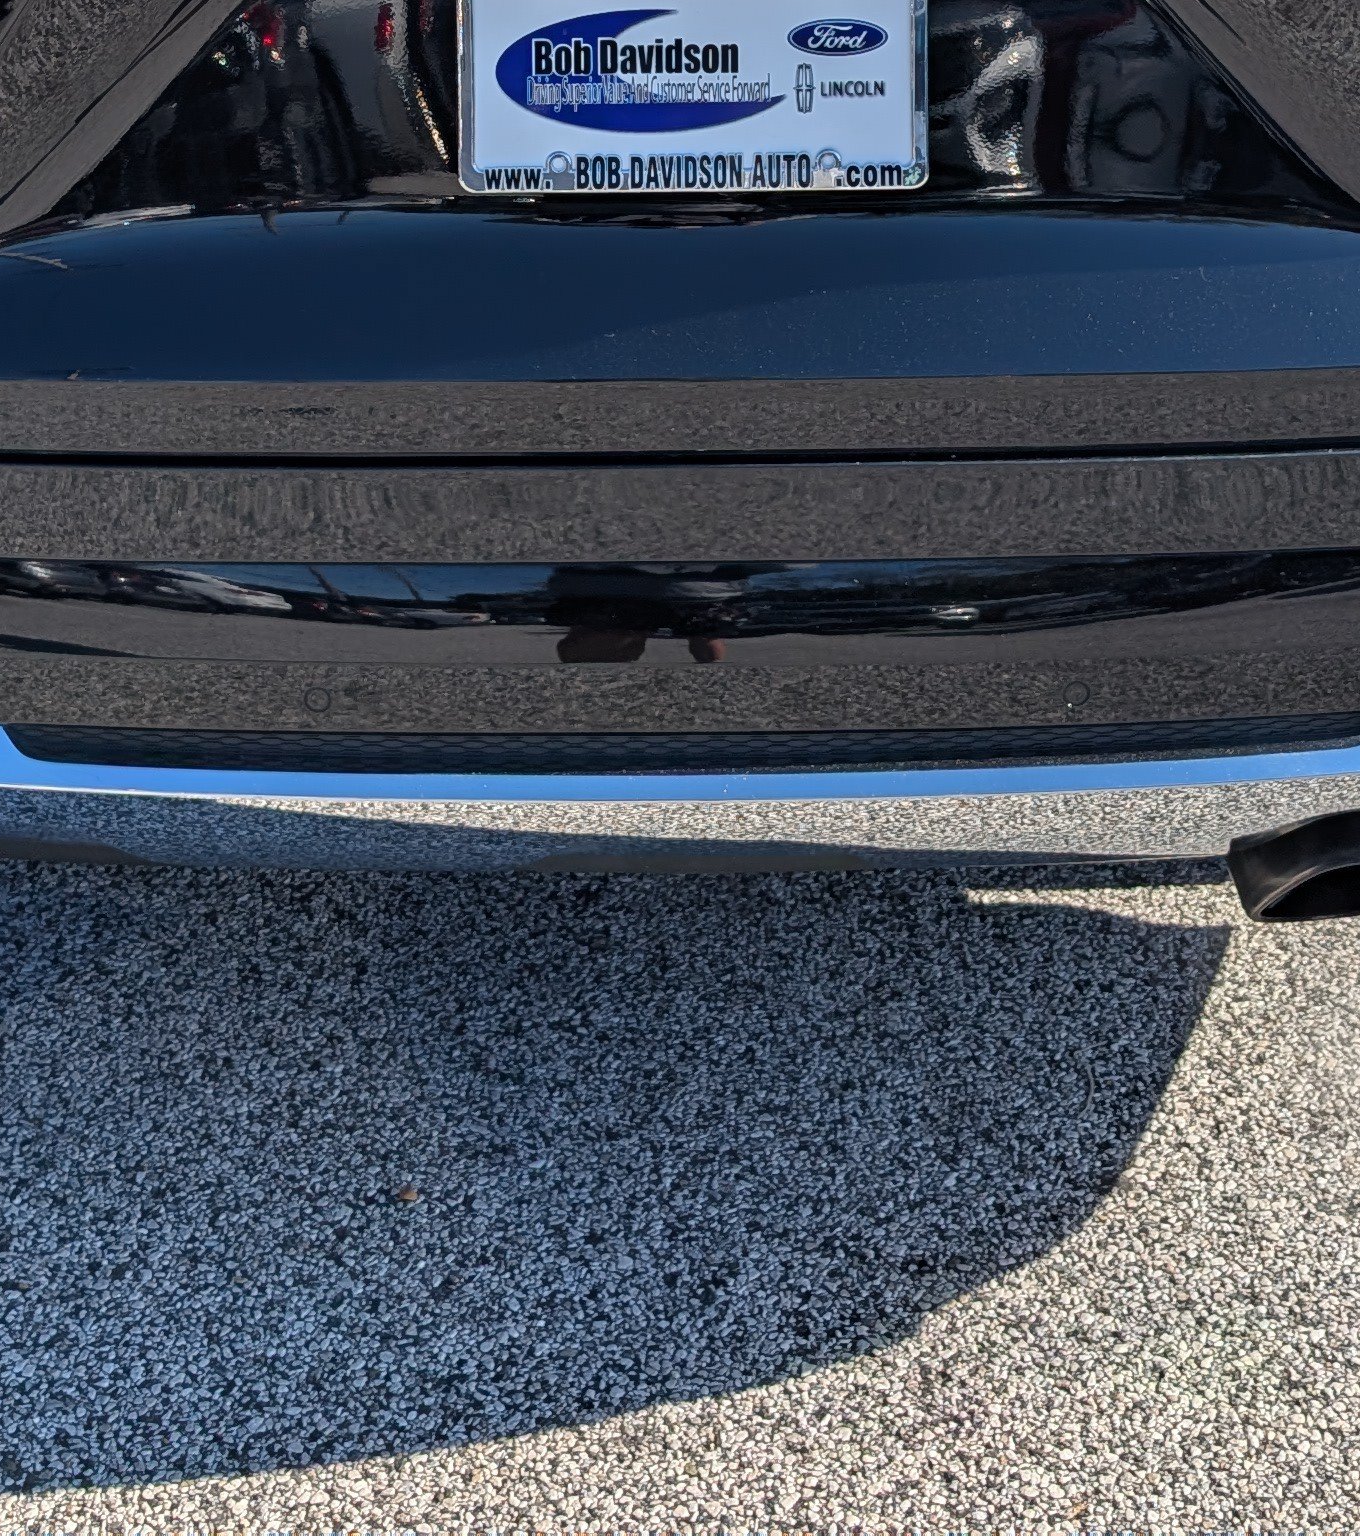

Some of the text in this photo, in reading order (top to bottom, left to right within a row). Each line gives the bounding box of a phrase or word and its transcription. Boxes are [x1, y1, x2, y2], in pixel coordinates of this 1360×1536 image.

[533, 38, 740, 76] Bob Davidson
[527, 76, 562, 112] Driving
[562, 76, 601, 112] Superior
[650, 75, 697, 104] Customer
[697, 75, 732, 104] Service
[732, 73, 771, 103] Forward
[820, 80, 886, 97] LINCOLN
[484, 153, 903, 190] www. BOB DAVIDSON AUTO .com
